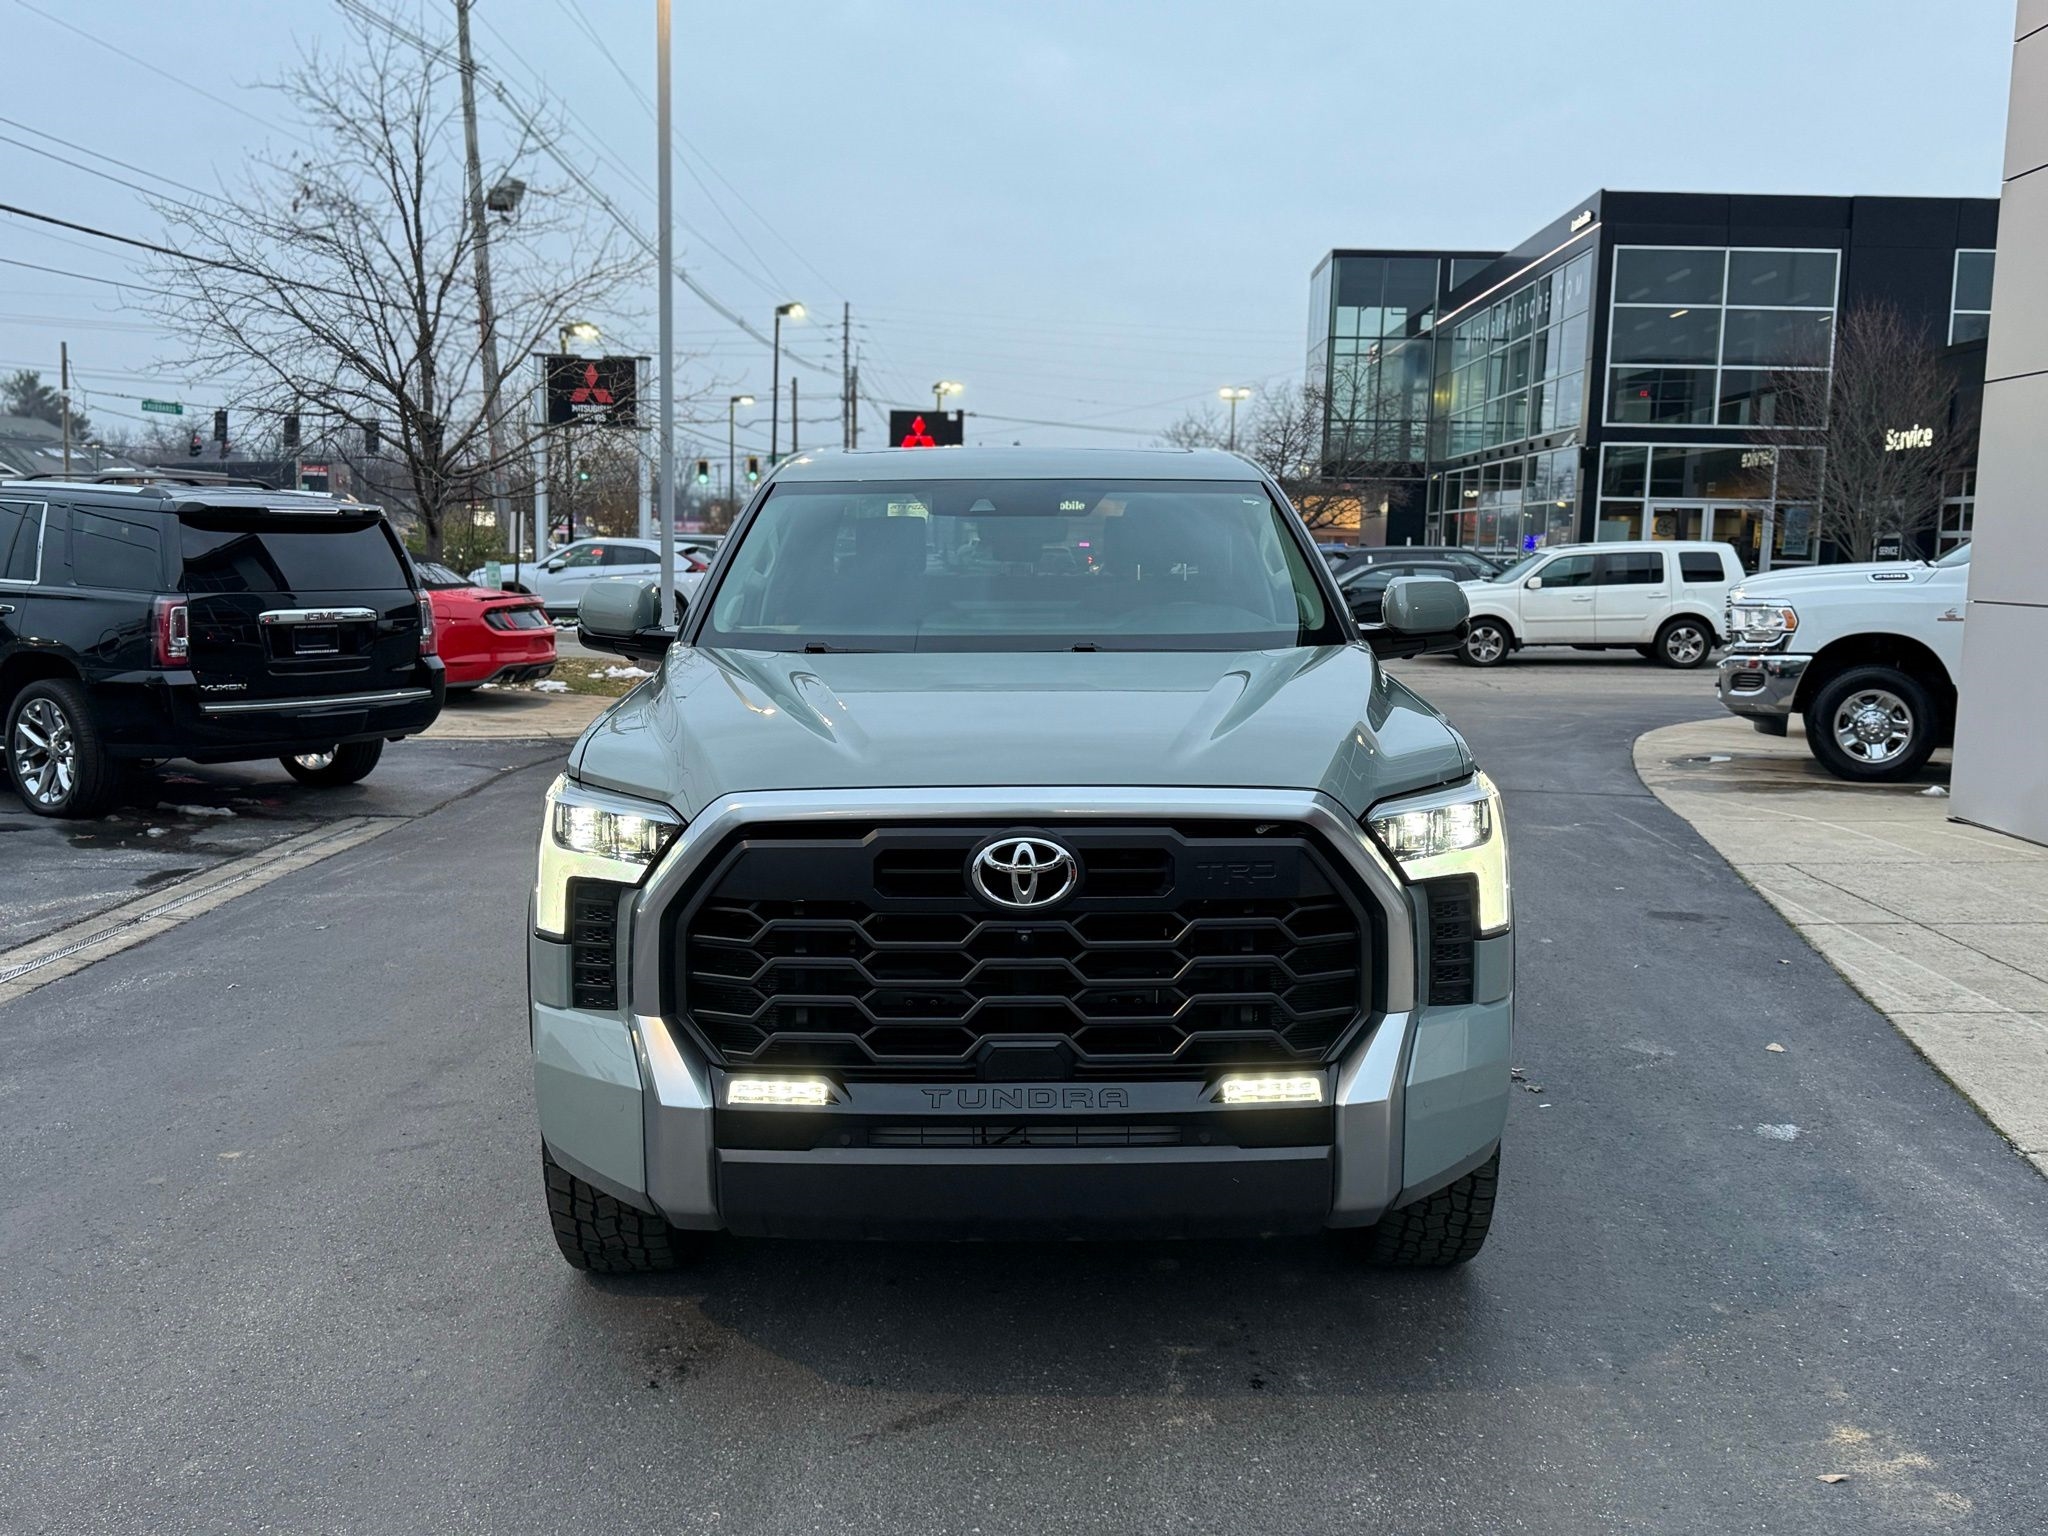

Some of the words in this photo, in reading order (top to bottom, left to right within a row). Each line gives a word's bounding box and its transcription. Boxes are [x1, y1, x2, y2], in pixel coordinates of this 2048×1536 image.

[1885, 424, 1934, 451] Service
[200, 683, 248, 691] YUKON
[1196, 864, 1278, 885] TRD
[921, 1088, 1129, 1109] TUNDRA
